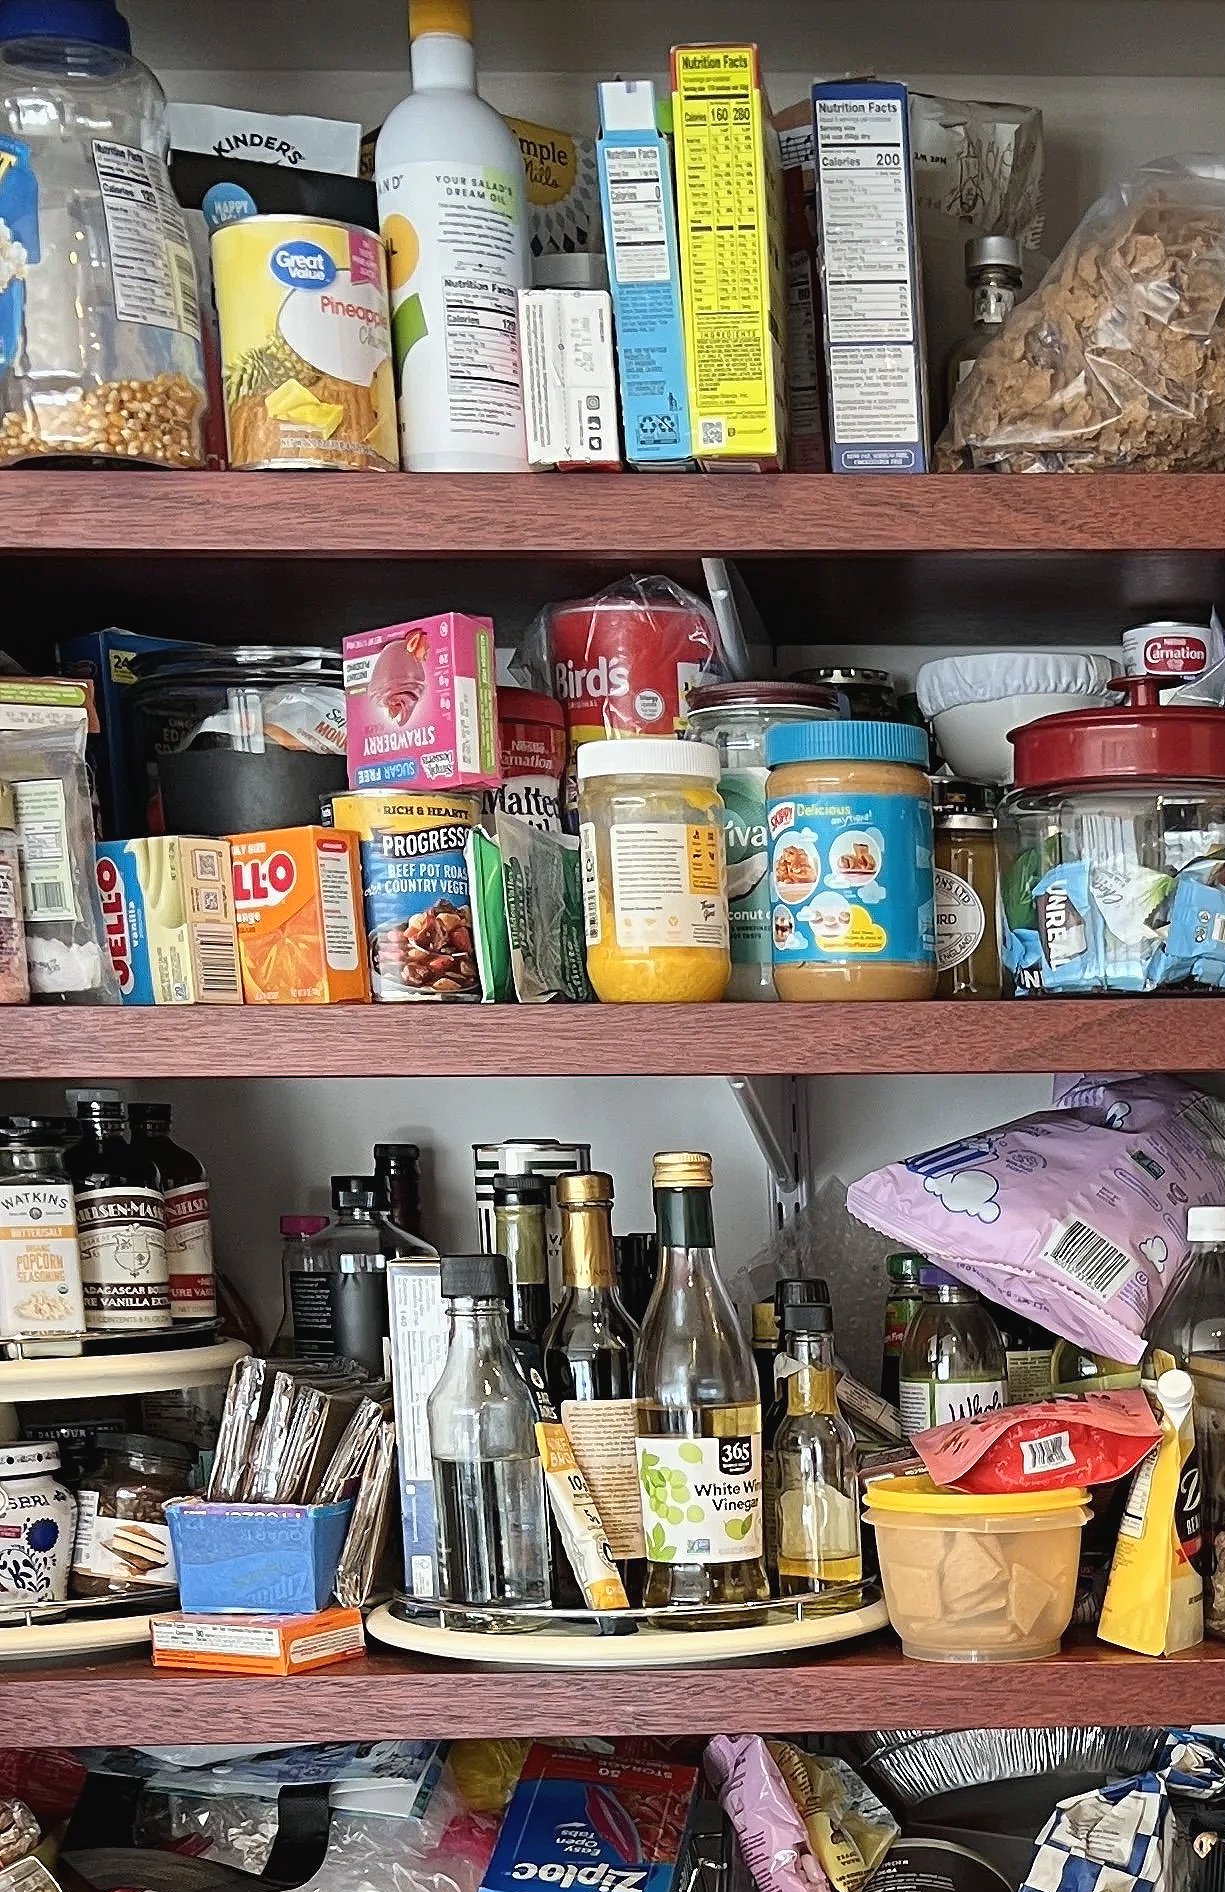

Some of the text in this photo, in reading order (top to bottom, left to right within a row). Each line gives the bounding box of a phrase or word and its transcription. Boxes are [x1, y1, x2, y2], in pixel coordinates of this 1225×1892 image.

[682, 55, 748, 70] Nutrition Facts
[818, 102, 897, 114] Nutrition Facts
[212, 133, 304, 165] KINDER'S
[822, 153, 900, 167] Calories 200
[435, 175, 513, 196] YOUR SALAD'S
[446, 188, 486, 200] DREAM
[276, 250, 325, 271] Great
[289, 264, 327, 281] Value
[444, 279, 515, 298] Nutrition Facts
[1145, 641, 1206, 663] Carnation
[556, 656, 630, 698] Bird's
[363, 725, 435, 757] STRAWBERRY
[358, 761, 415, 785] SUGAR FREE
[383, 805, 414, 817] RICH
[796, 803, 851, 817] Delicious
[388, 864, 440, 879] BEEF POT
[385, 878, 439, 894] COUNTRY
[127, 900, 138, 947] vanilla
[1044, 881, 1069, 973] UNREAL
[1, 1192, 69, 1210] WATKINS
[16, 1255, 64, 1271] POPCORN
[18, 1271, 65, 1282] SEASONING
[101, 1297, 150, 1307] VANILLA
[39, 1429, 87, 1439] BALFOUR
[721, 1442, 750, 1463] 365
[694, 1482, 741, 1497] White
[555, 1837, 598, 1849] Open
